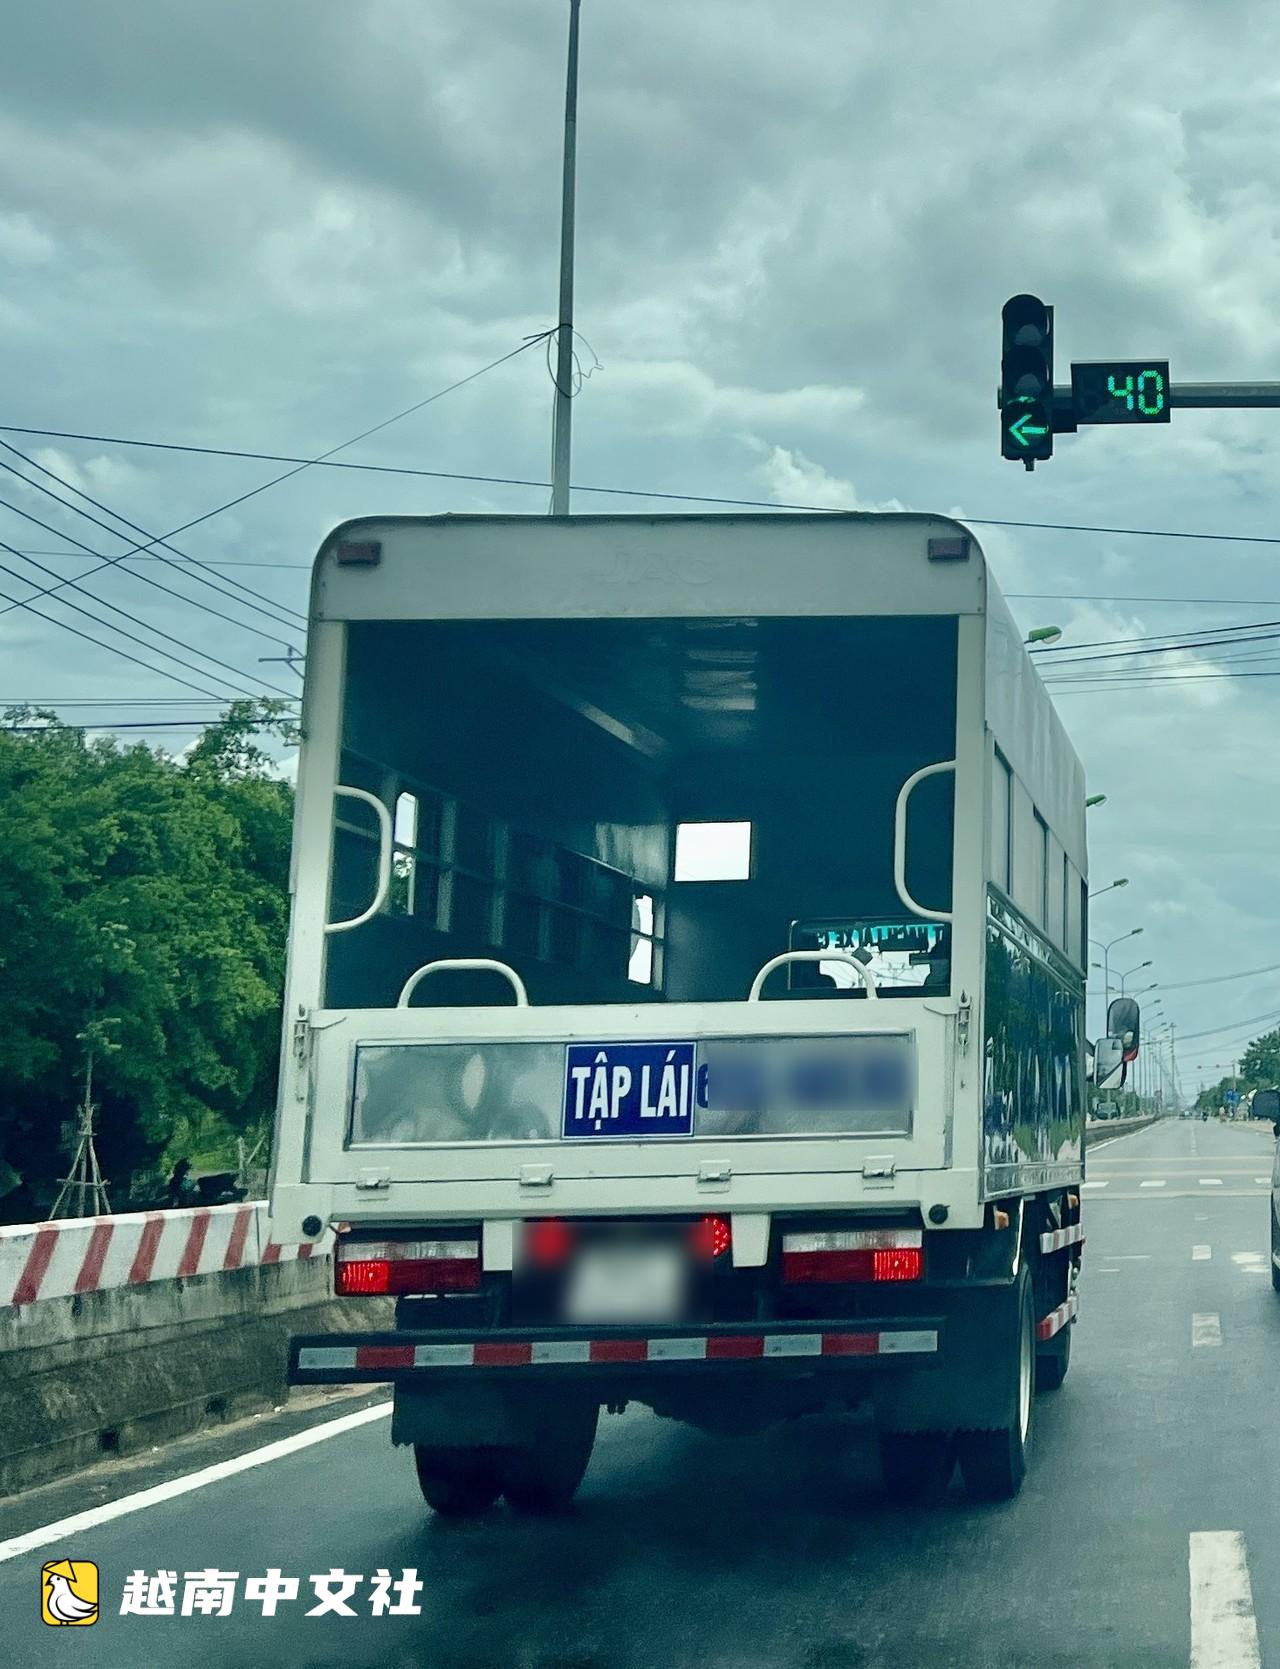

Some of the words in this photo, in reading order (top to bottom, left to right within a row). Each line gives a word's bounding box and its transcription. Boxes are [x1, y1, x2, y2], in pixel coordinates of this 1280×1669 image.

[1107, 370, 1164, 415] 40
[571, 1051, 631, 1130] TẬP
[640, 1050, 690, 1118] LÁI
